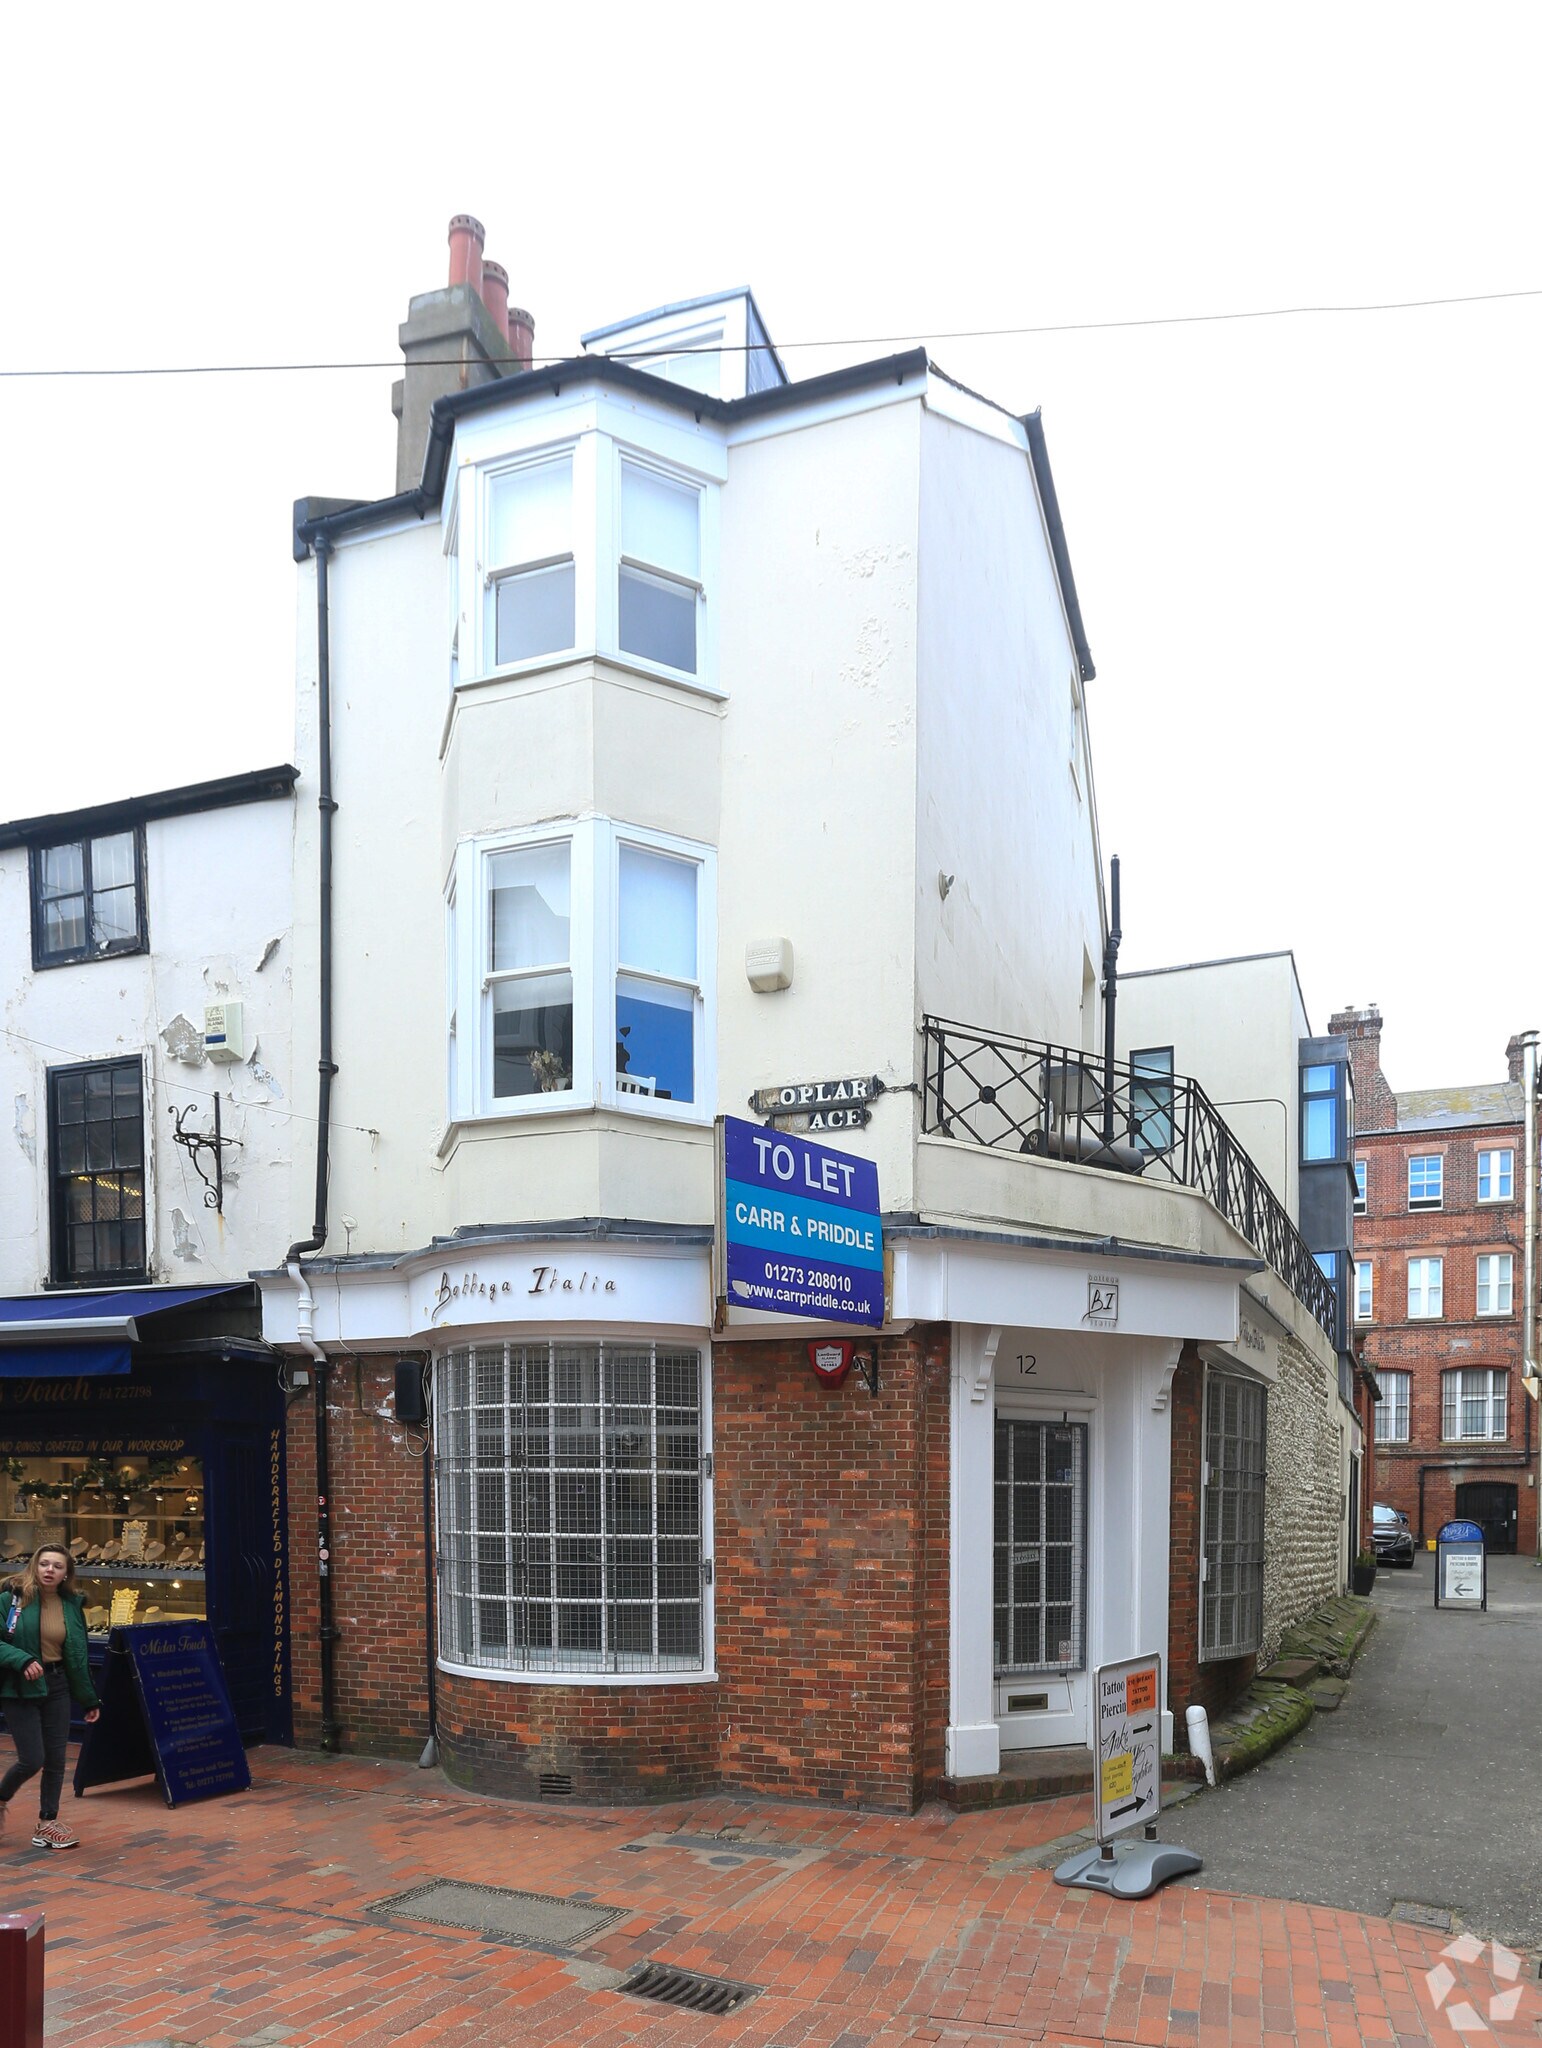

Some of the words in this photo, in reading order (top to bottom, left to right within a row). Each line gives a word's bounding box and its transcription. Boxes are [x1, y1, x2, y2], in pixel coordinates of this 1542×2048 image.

[780, 1080, 867, 1105] OPLAR
[810, 1110, 861, 1130] ACE
[753, 1137, 795, 1181] TO
[805, 1153, 855, 1197] LET
[735, 1202, 785, 1233] CARR
[790, 1216, 802, 1236] &
[807, 1218, 874, 1251] PRIDDLE
[765, 1262, 804, 1284] 01273
[807, 1271, 851, 1292] 208010
[431, 1272, 511, 1322] Bottega
[528, 1267, 617, 1294] Italia
[1016, 1355, 1036, 1374] 12
[14, 1376, 91, 1403] Touch
[115, 1386, 152, 1399] 727198
[16, 1440, 42, 1453] RINGS
[45, 1440, 84, 1452] CRAFTED
[87, 1439, 98, 1452] IN
[102, 1439, 123, 1452] OUR
[128, 1439, 185, 1452] WORKSHOP
[270, 1429, 282, 1552] HANDCRAFTED
[273, 1558, 283, 1636] DIAMOND
[140, 1638, 176, 1656] Midas
[178, 1635, 207, 1652] Touch
[273, 1641, 282, 1697] RINGS
[1102, 1681, 1125, 1697] Tattoo
[1101, 1699, 1126, 1719] Piercin
